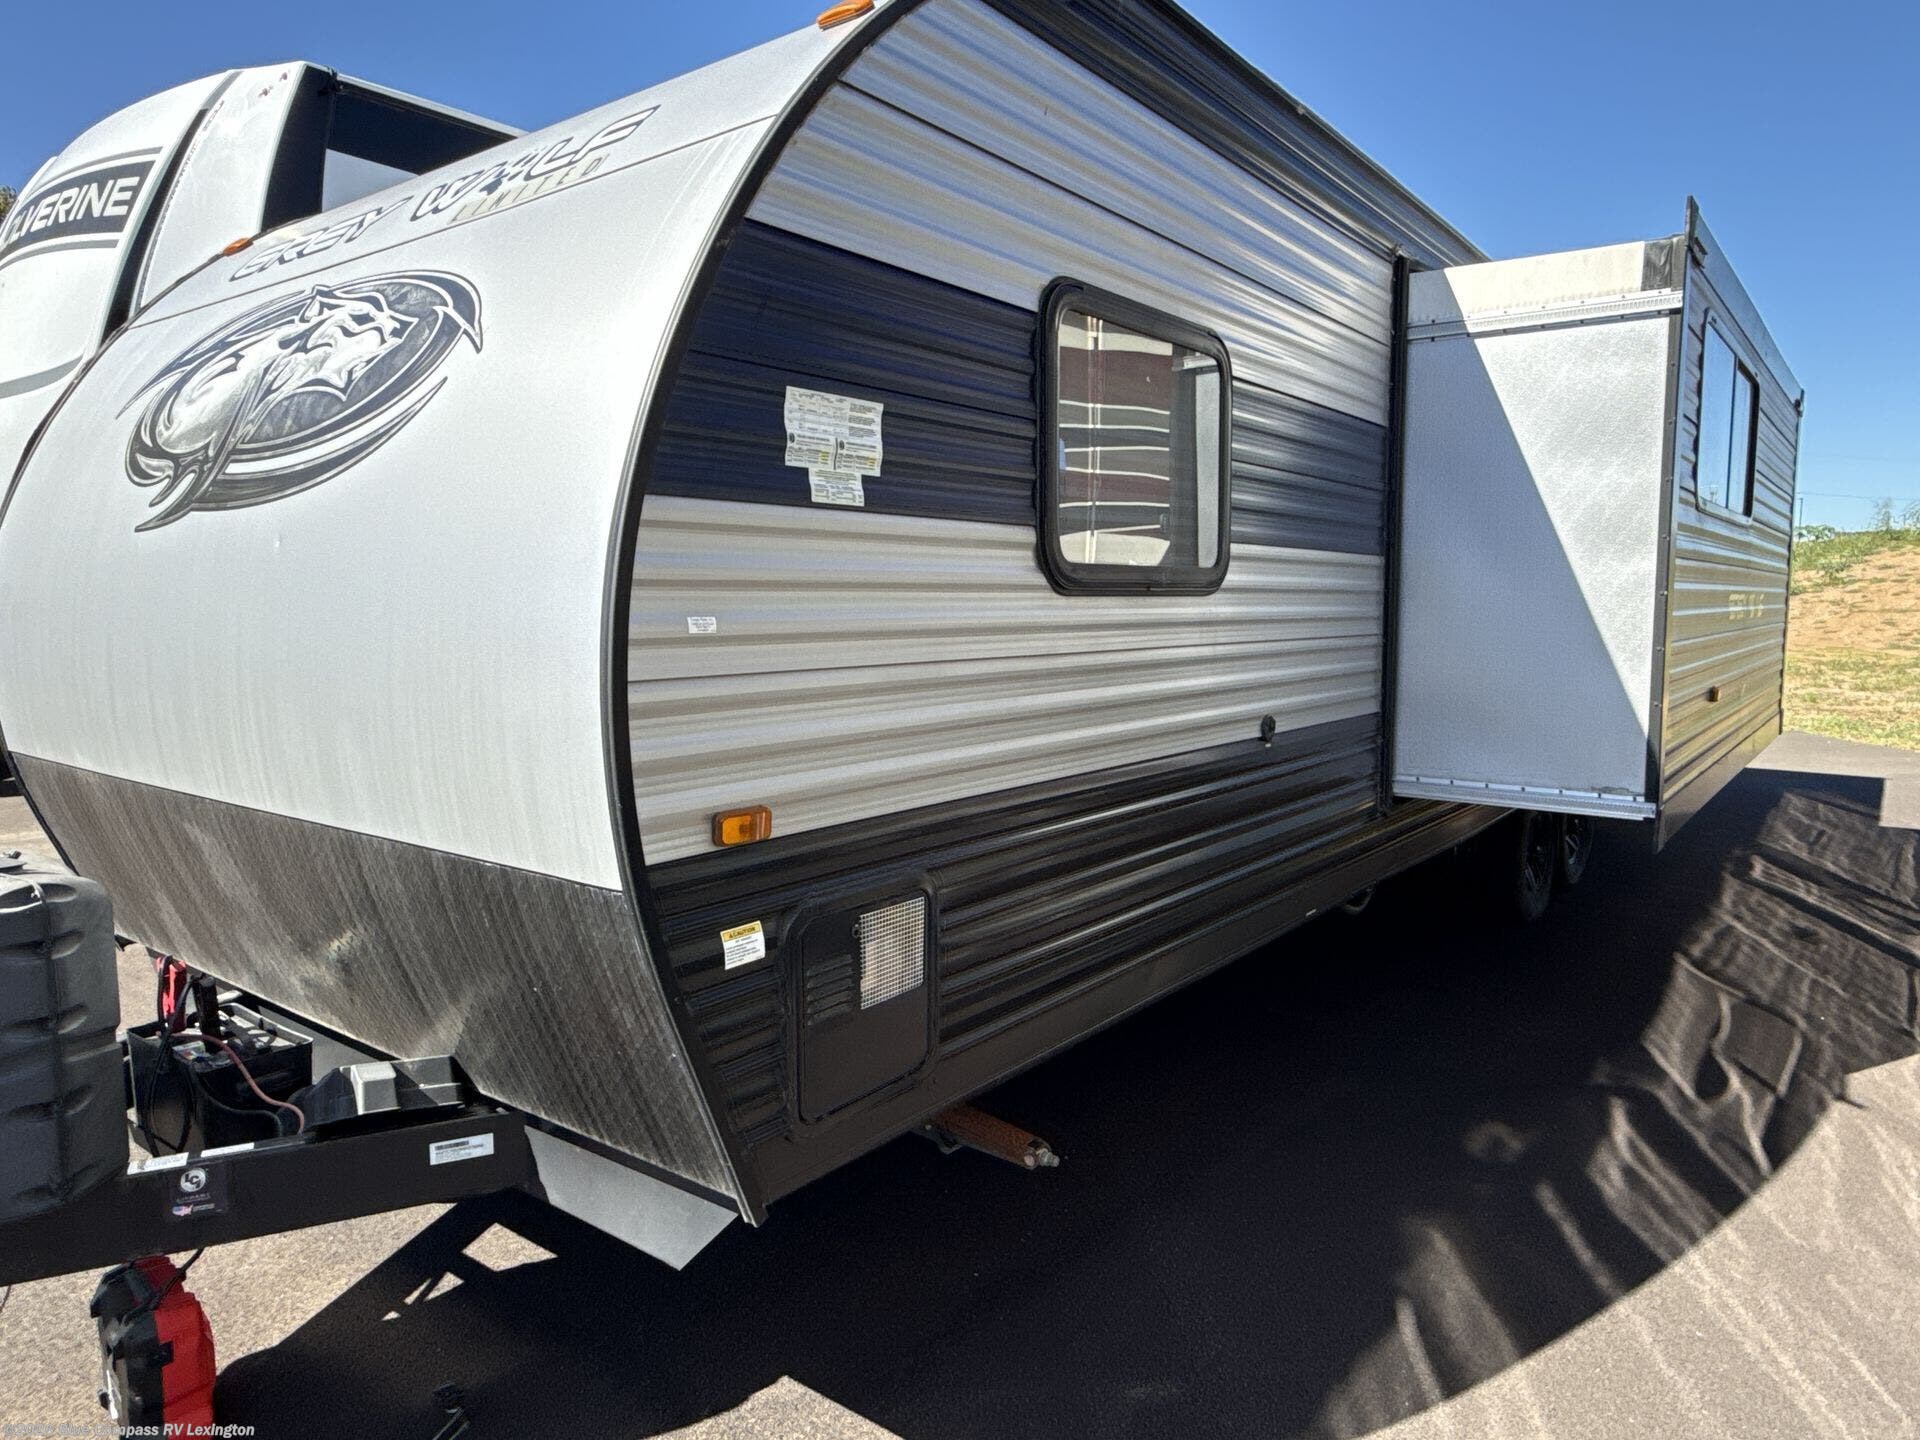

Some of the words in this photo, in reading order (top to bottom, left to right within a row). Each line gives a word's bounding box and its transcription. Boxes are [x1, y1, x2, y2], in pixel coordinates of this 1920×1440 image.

[4, 176, 140, 246] OLVERINE
[229, 195, 415, 282] GREY
[409, 104, 662, 222] WOLF
